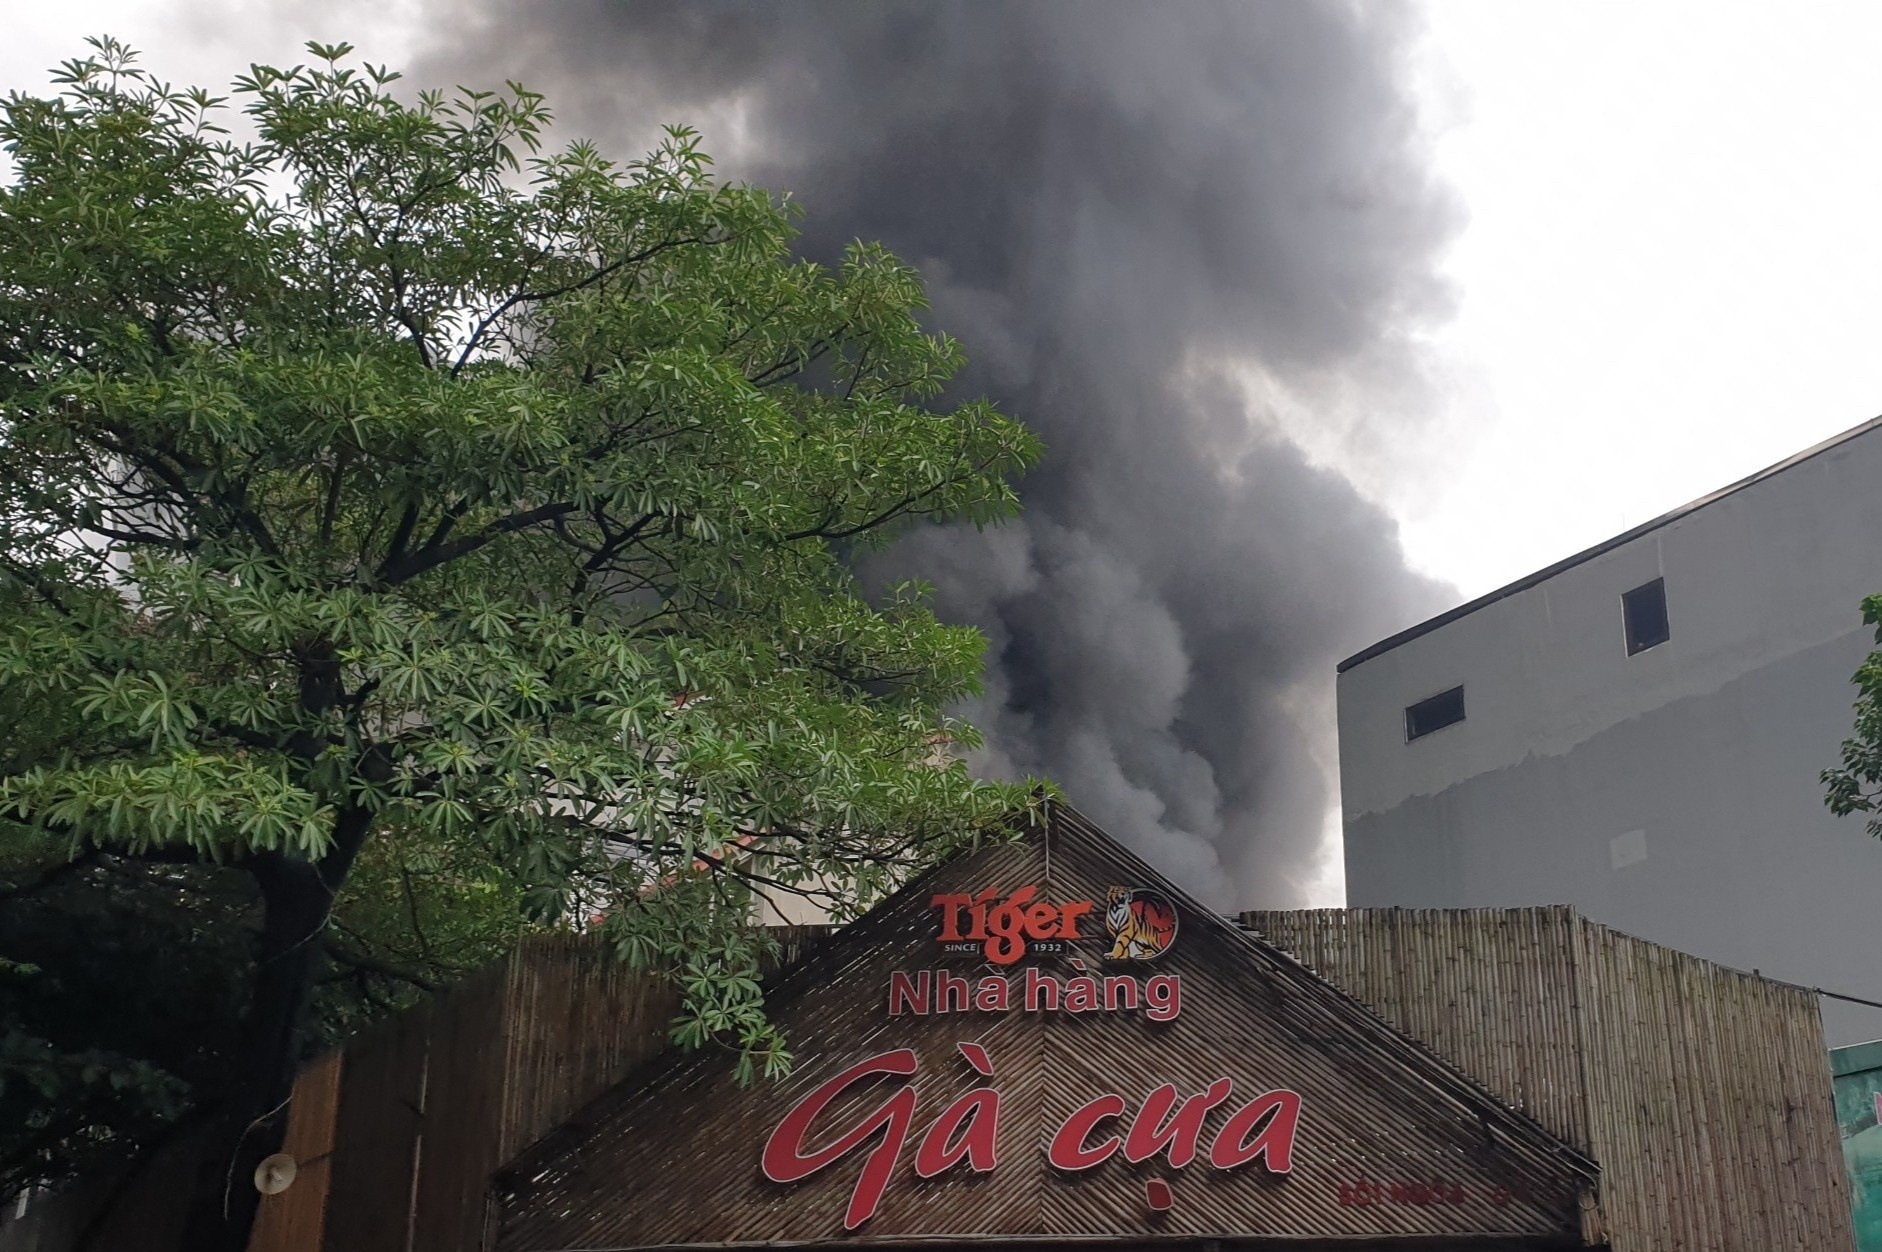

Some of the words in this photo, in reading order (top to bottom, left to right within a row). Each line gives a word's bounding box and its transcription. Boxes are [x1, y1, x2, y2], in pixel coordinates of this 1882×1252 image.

[931, 886, 1094, 964] Tiger
[944, 943, 977, 952] SINCE
[1033, 942, 1062, 952] 1932
[889, 964, 1010, 1015] Nhà
[1024, 957, 1182, 1021] hàng
[762, 1042, 1000, 1229] Gà
[1048, 1077, 1301, 1210] cựa
